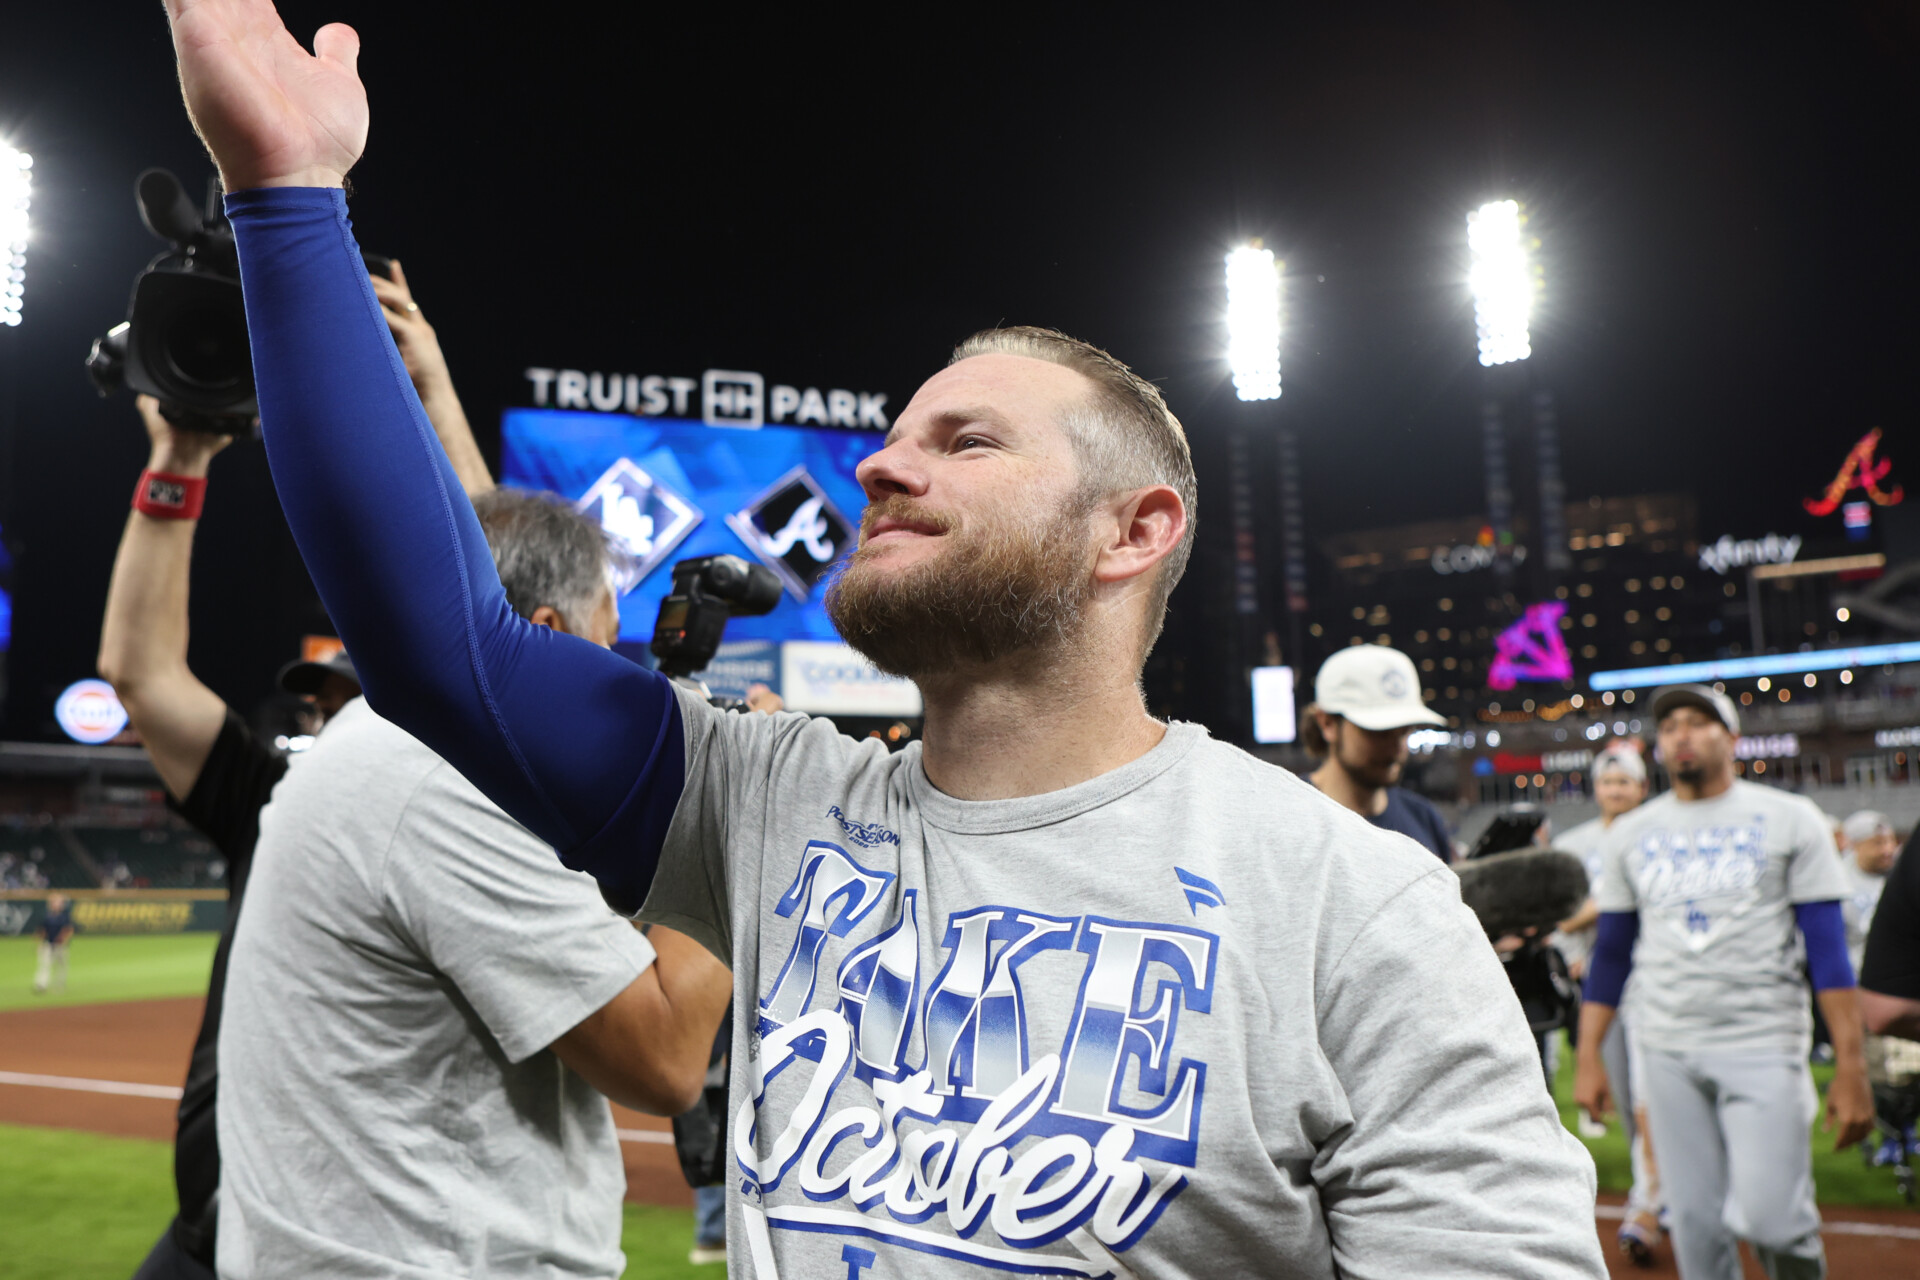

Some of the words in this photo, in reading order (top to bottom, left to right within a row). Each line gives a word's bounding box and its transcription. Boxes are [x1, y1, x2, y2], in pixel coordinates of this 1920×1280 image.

[525, 367, 697, 416] TRUIST
[769, 385, 889, 431] PARK
[1698, 532, 1802, 575] xfinity
[755, 839, 1219, 1167] TAKE
[734, 1009, 1188, 1251] October
